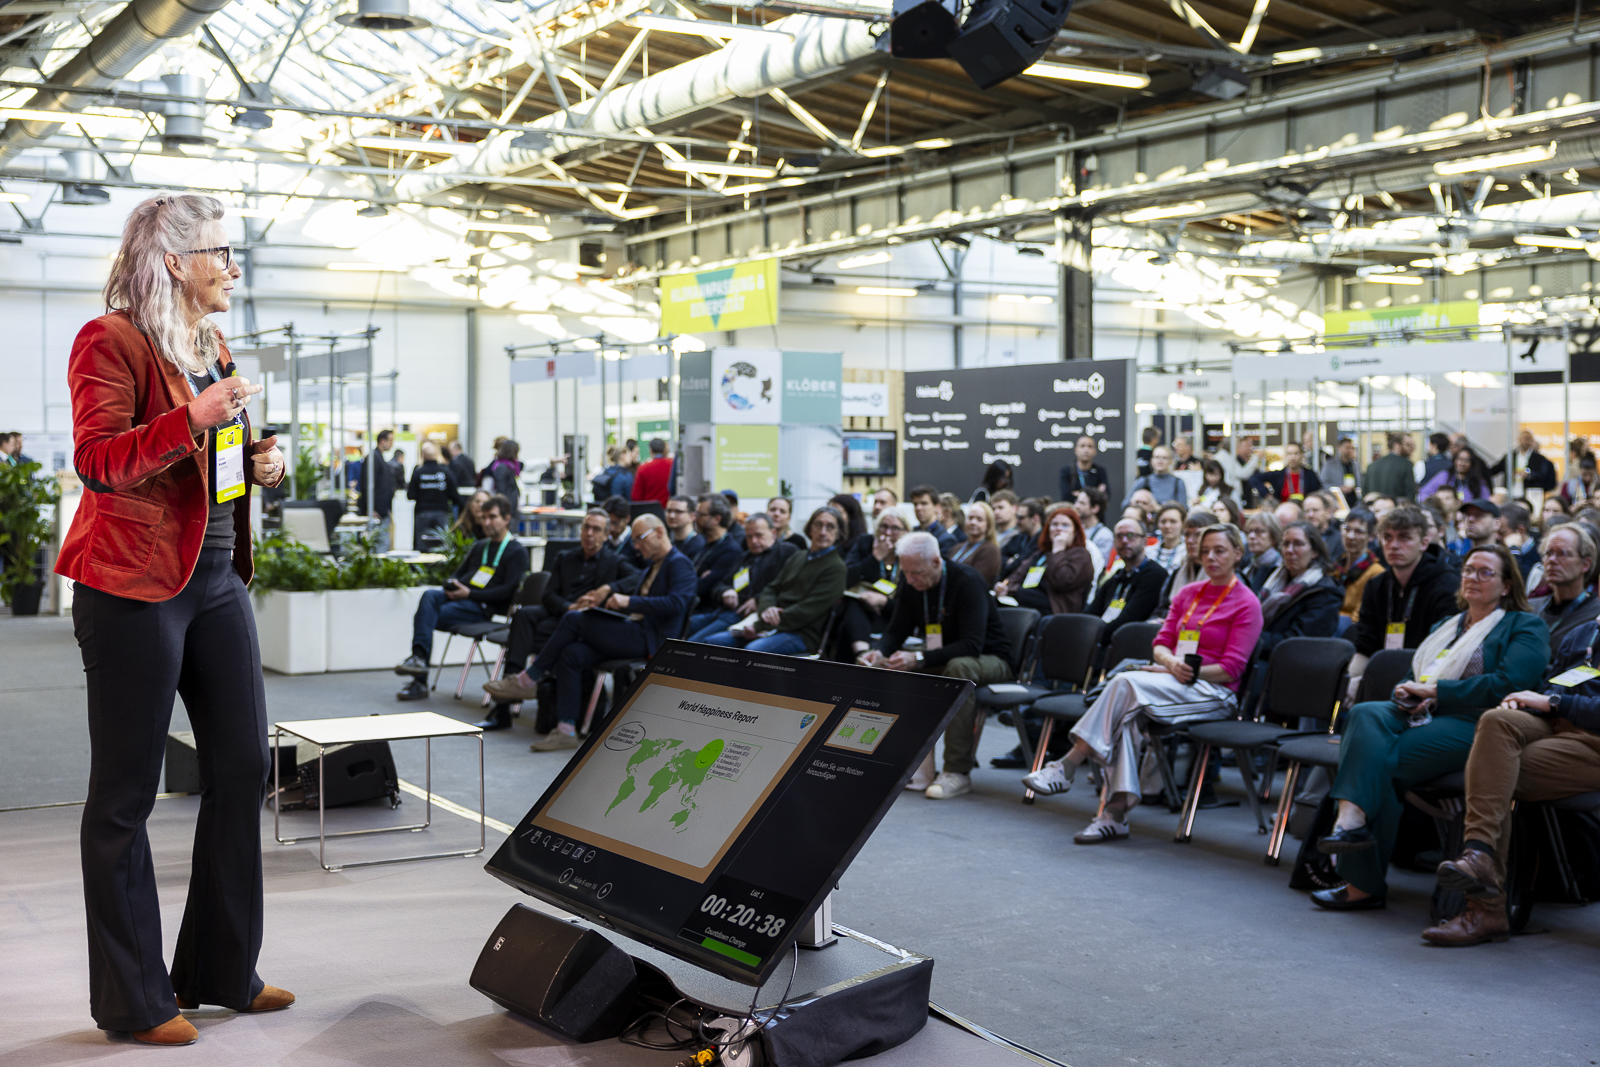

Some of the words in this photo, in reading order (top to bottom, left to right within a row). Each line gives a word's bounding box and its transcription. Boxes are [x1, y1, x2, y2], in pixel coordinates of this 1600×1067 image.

[681, 377, 710, 390] KLÖBER
[785, 378, 837, 392] KLÖBER
[678, 700, 700, 712] World
[697, 704, 733, 719] Happiness
[732, 710, 759, 724] Report
[806, 767, 837, 780] hinzuzufügen
[812, 759, 829, 769] Klicken
[828, 762, 836, 770] Sie,
[845, 766, 864, 776] Notizen
[750, 889, 761, 898] List
[700, 894, 786, 938] 00:20:38
[704, 926, 730, 941] Countdown
[728, 936, 747, 948] Change
